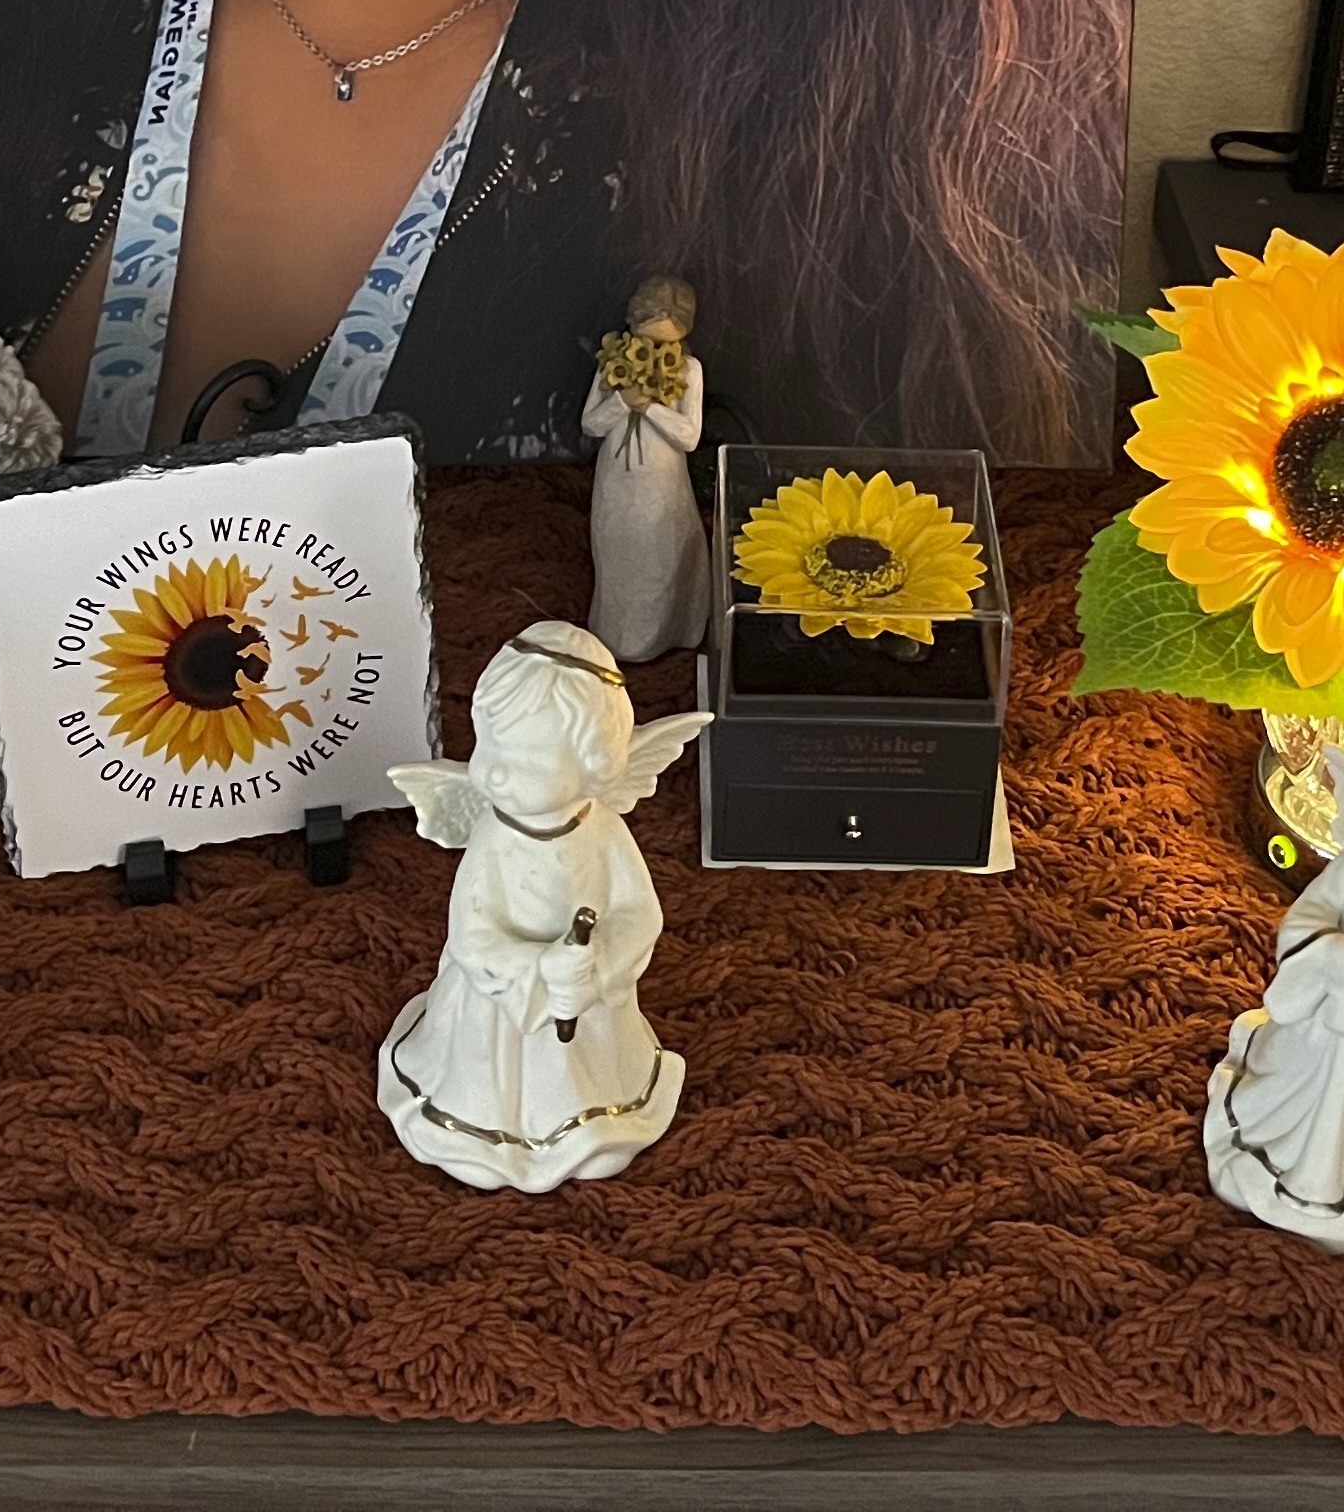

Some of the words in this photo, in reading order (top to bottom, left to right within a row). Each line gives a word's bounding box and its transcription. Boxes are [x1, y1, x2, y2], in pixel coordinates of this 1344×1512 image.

[53, 596, 105, 670] YOUR
[96, 524, 194, 590] WINGS
[210, 517, 291, 547] WERE
[295, 533, 371, 604] READY
[58, 711, 104, 758] BUT
[100, 759, 156, 801] OUR
[168, 770, 281, 808] HEARTS
[288, 713, 358, 776] WERE
[347, 652, 384, 704] NOT
